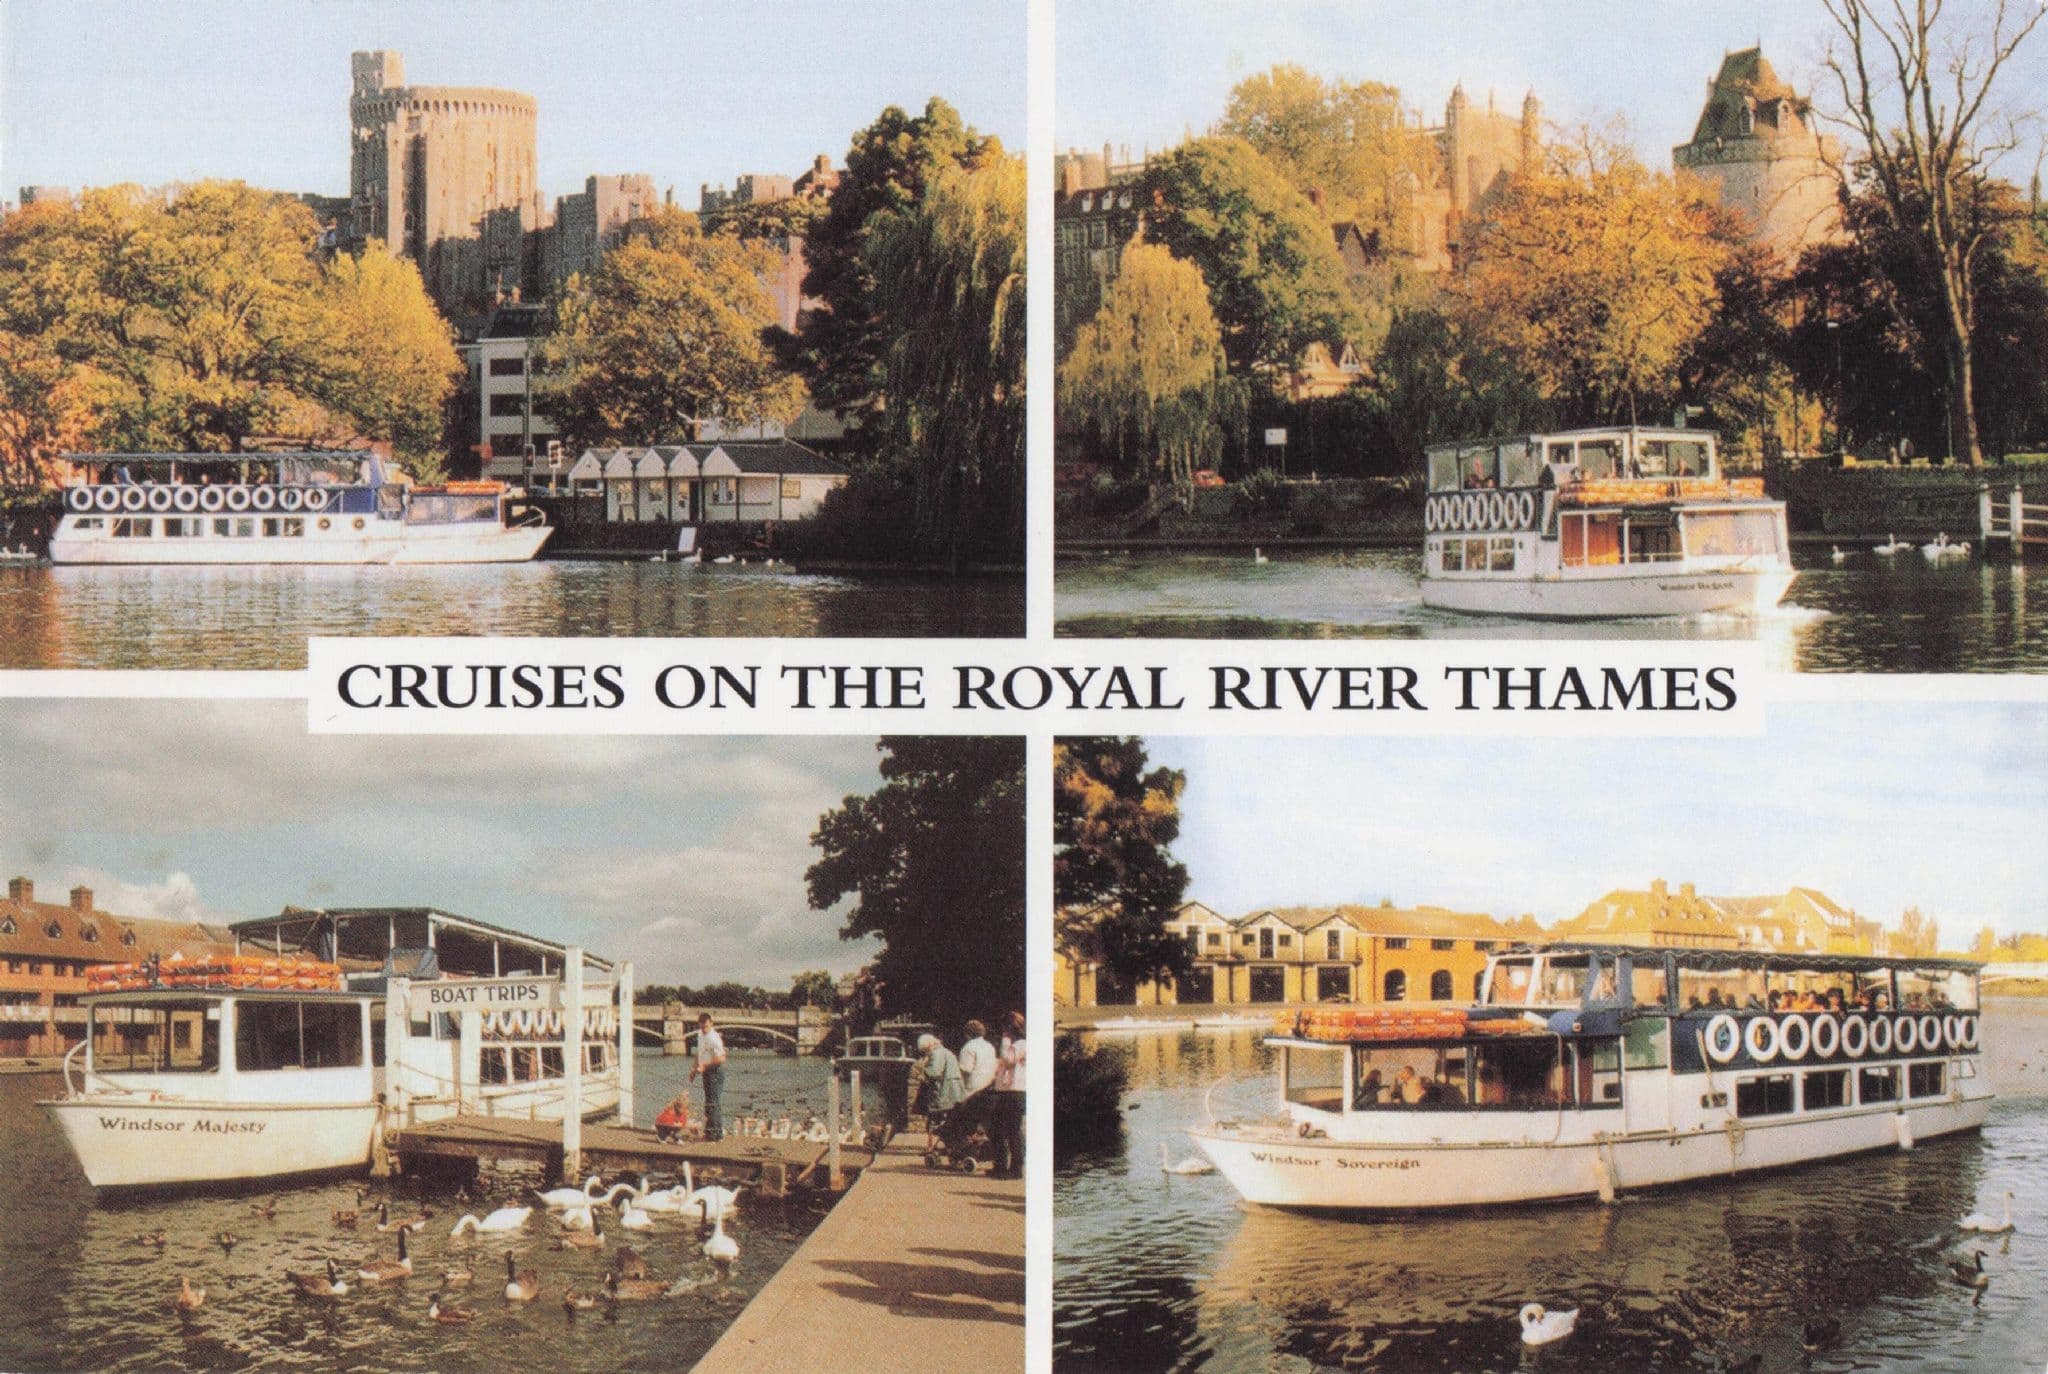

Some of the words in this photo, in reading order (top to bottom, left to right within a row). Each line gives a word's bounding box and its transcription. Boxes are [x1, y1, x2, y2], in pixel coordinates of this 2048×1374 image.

[430, 987, 477, 1003] BOAT
[484, 984, 539, 1001] TRIPS
[99, 1116, 185, 1131] Windsor
[192, 1119, 266, 1134] Majesty
[1251, 1151, 1321, 1167] Windsor
[1336, 1158, 1421, 1170] Sovereign
